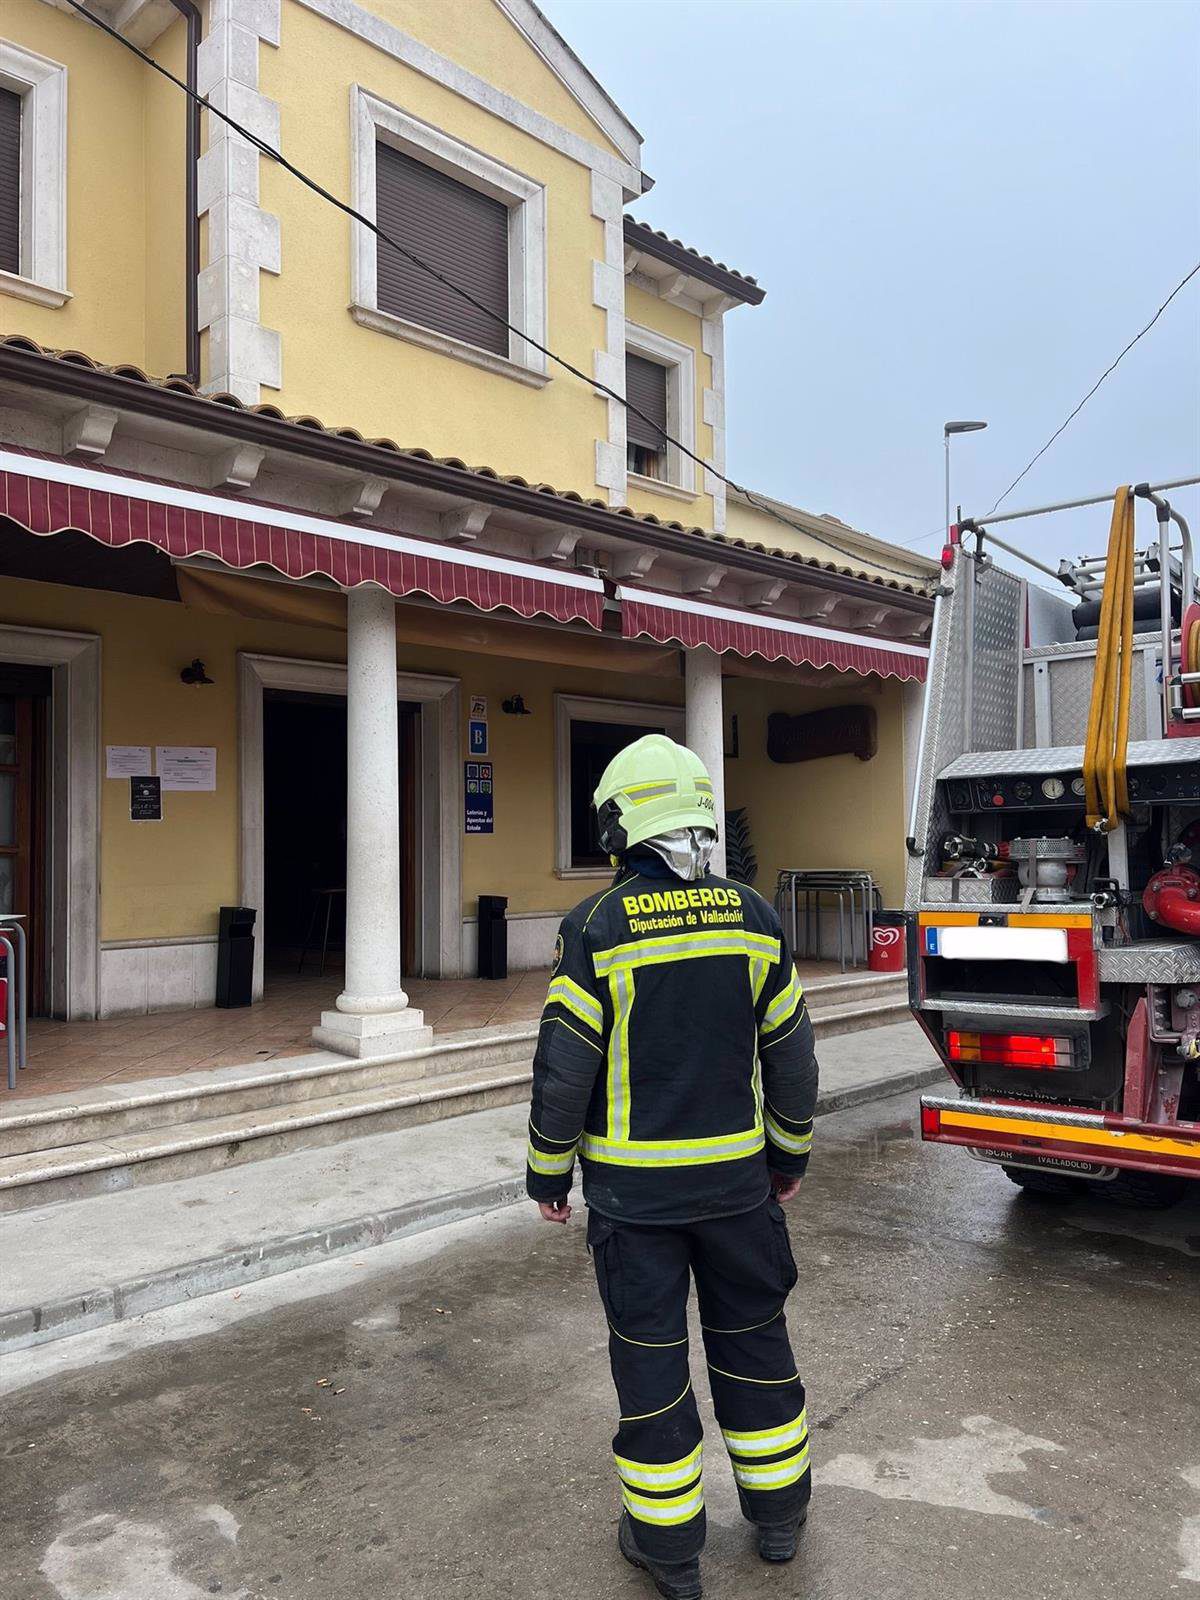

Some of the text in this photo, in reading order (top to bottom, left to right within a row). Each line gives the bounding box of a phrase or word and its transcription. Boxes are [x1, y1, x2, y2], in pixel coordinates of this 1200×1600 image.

[474, 730, 483, 745] B
[622, 888, 742, 915] BOMBEROS
[629, 913, 685, 934] Diputación
[686, 911, 698, 926] de
[929, 943, 936, 951] E
[985, 1147, 1092, 1171] ISCAR (VALLADOLID)
